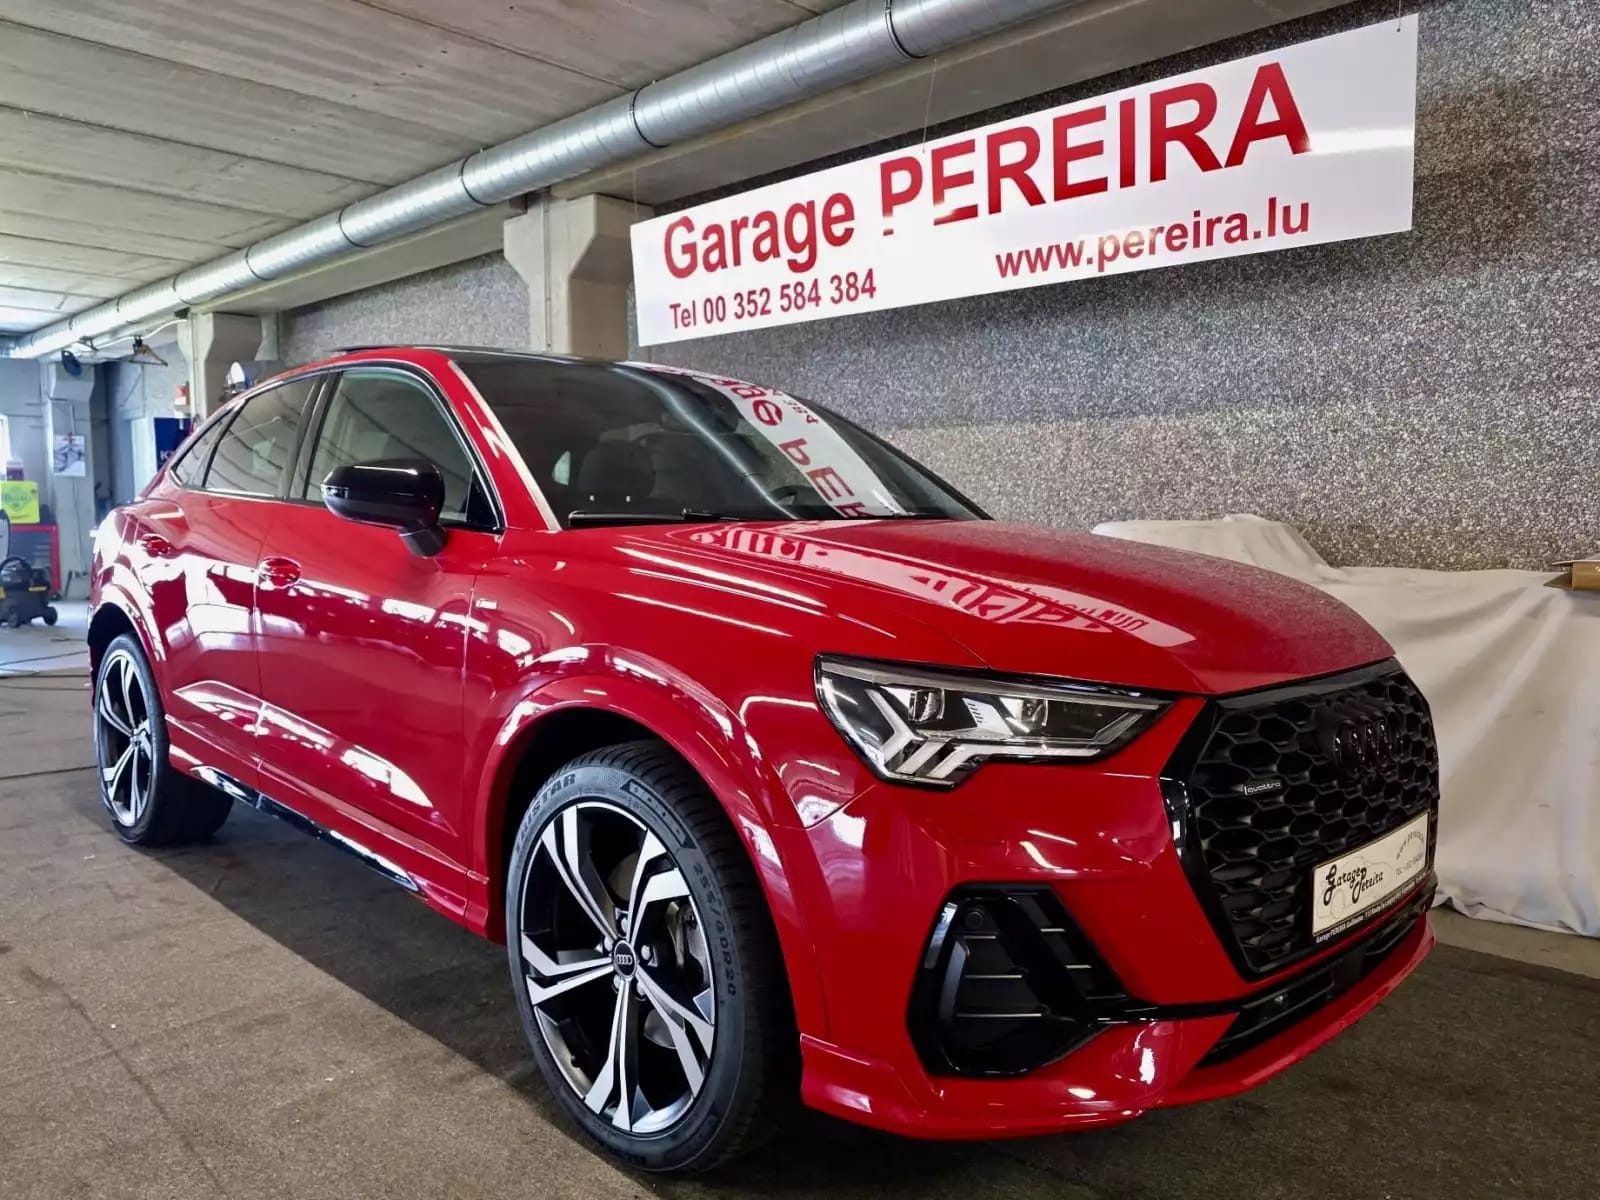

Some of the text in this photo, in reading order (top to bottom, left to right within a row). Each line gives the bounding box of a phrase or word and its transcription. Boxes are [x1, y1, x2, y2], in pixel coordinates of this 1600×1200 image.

[663, 62, 1310, 279] Garage PEREIRA
[995, 196, 1310, 278] www.pereira.lu
[669, 268, 877, 329] Tel 00 352 584 384
[1246, 782, 1281, 795] quattro
[1323, 864, 1361, 906] Garage
